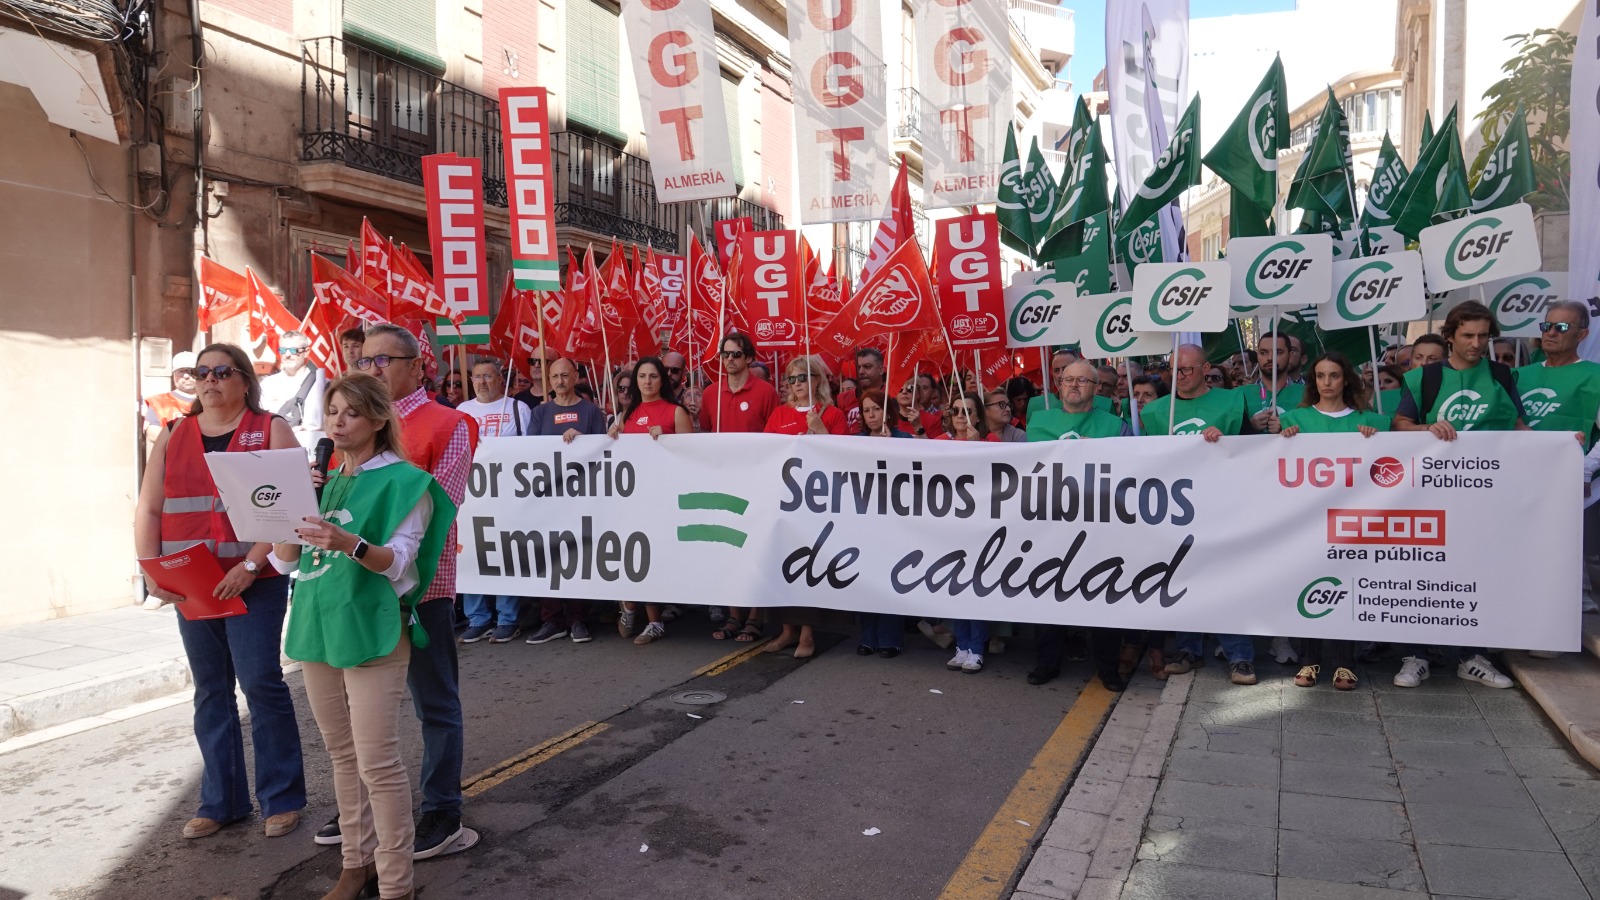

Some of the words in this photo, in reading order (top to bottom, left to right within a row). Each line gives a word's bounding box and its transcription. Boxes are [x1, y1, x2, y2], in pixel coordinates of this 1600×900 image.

[638, 0, 704, 162] GT
[934, 0, 990, 163] GT
[1483, 140, 1519, 181] SIF
[507, 95, 549, 255] CCOO
[663, 168, 726, 190] ALMERÍA
[933, 173, 1001, 194] ALMERÍ
[1023, 164, 1052, 208] CSIF
[1371, 156, 1404, 205] CSIF
[810, 191, 882, 211] ALMERÍA
[437, 164, 479, 311] CCOO
[1457, 230, 1514, 262] CSIF
[753, 235, 788, 317] UGT
[948, 220, 990, 312] UGT
[1258, 258, 1313, 280] CSIF
[661, 258, 684, 309] UGT
[1349, 276, 1403, 303] CSIF
[1161, 285, 1213, 306] CSIF
[1500, 293, 1558, 314] CSIF
[954, 318, 970, 329] UGT
[974, 317, 988, 325] FSP
[1019, 304, 1062, 325] CSIF
[1106, 314, 1134, 334] CS
[554, 413, 578, 421] CCOO
[1447, 403, 1489, 421] CSIF
[1522, 399, 1561, 416] CSIF
[467, 460, 502, 498] or
[513, 450, 636, 498] salario
[1278, 457, 1362, 488] UGT
[1421, 456, 1500, 471] Servicios
[779, 457, 976, 519] Servicios
[990, 461, 1195, 527] Públicos
[1421, 474, 1494, 489] Públicos
[257, 492, 282, 500] CSIF
[1335, 515, 1438, 539] CCOO
[472, 515, 651, 591] Empleo
[782, 520, 860, 590] de
[890, 525, 1195, 608] calidad
[1327, 546, 1368, 560] área
[1374, 547, 1446, 563] pública
[1358, 578, 1412, 590] Central
[1416, 579, 1477, 593] Sindical
[1306, 589, 1349, 606] CSIF
[1358, 594, 1465, 611] Independiente
[1469, 600, 1478, 612] y
[1358, 611, 1376, 623] de
[1380, 612, 1479, 627] Funcionarios
